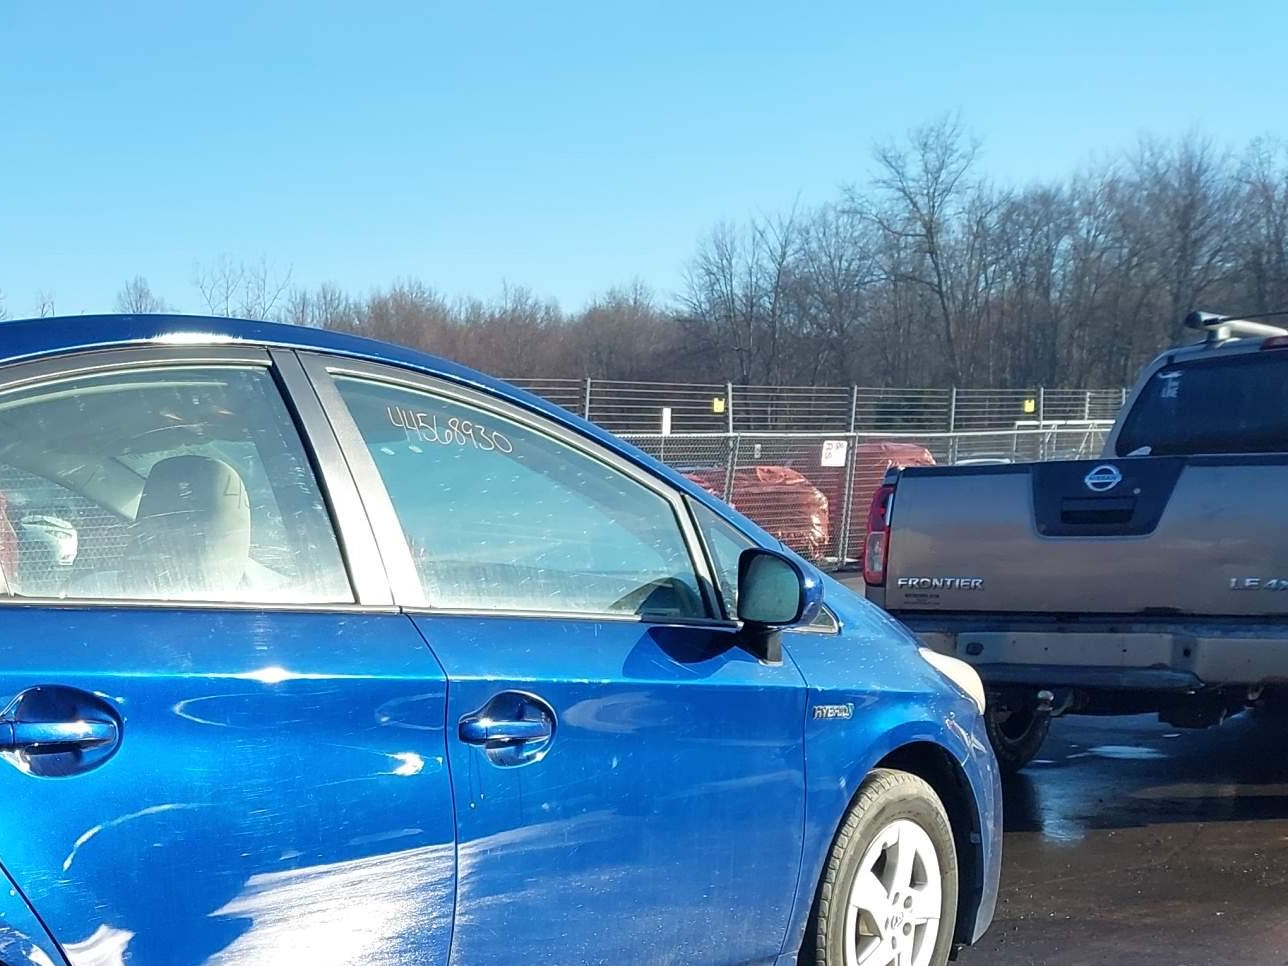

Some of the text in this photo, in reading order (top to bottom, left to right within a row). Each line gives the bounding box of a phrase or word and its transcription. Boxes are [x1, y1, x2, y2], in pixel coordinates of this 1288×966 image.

[387, 406, 513, 453] 44568930
[897, 577, 984, 590] FRONTIER
[813, 704, 852, 719] HYBRID
